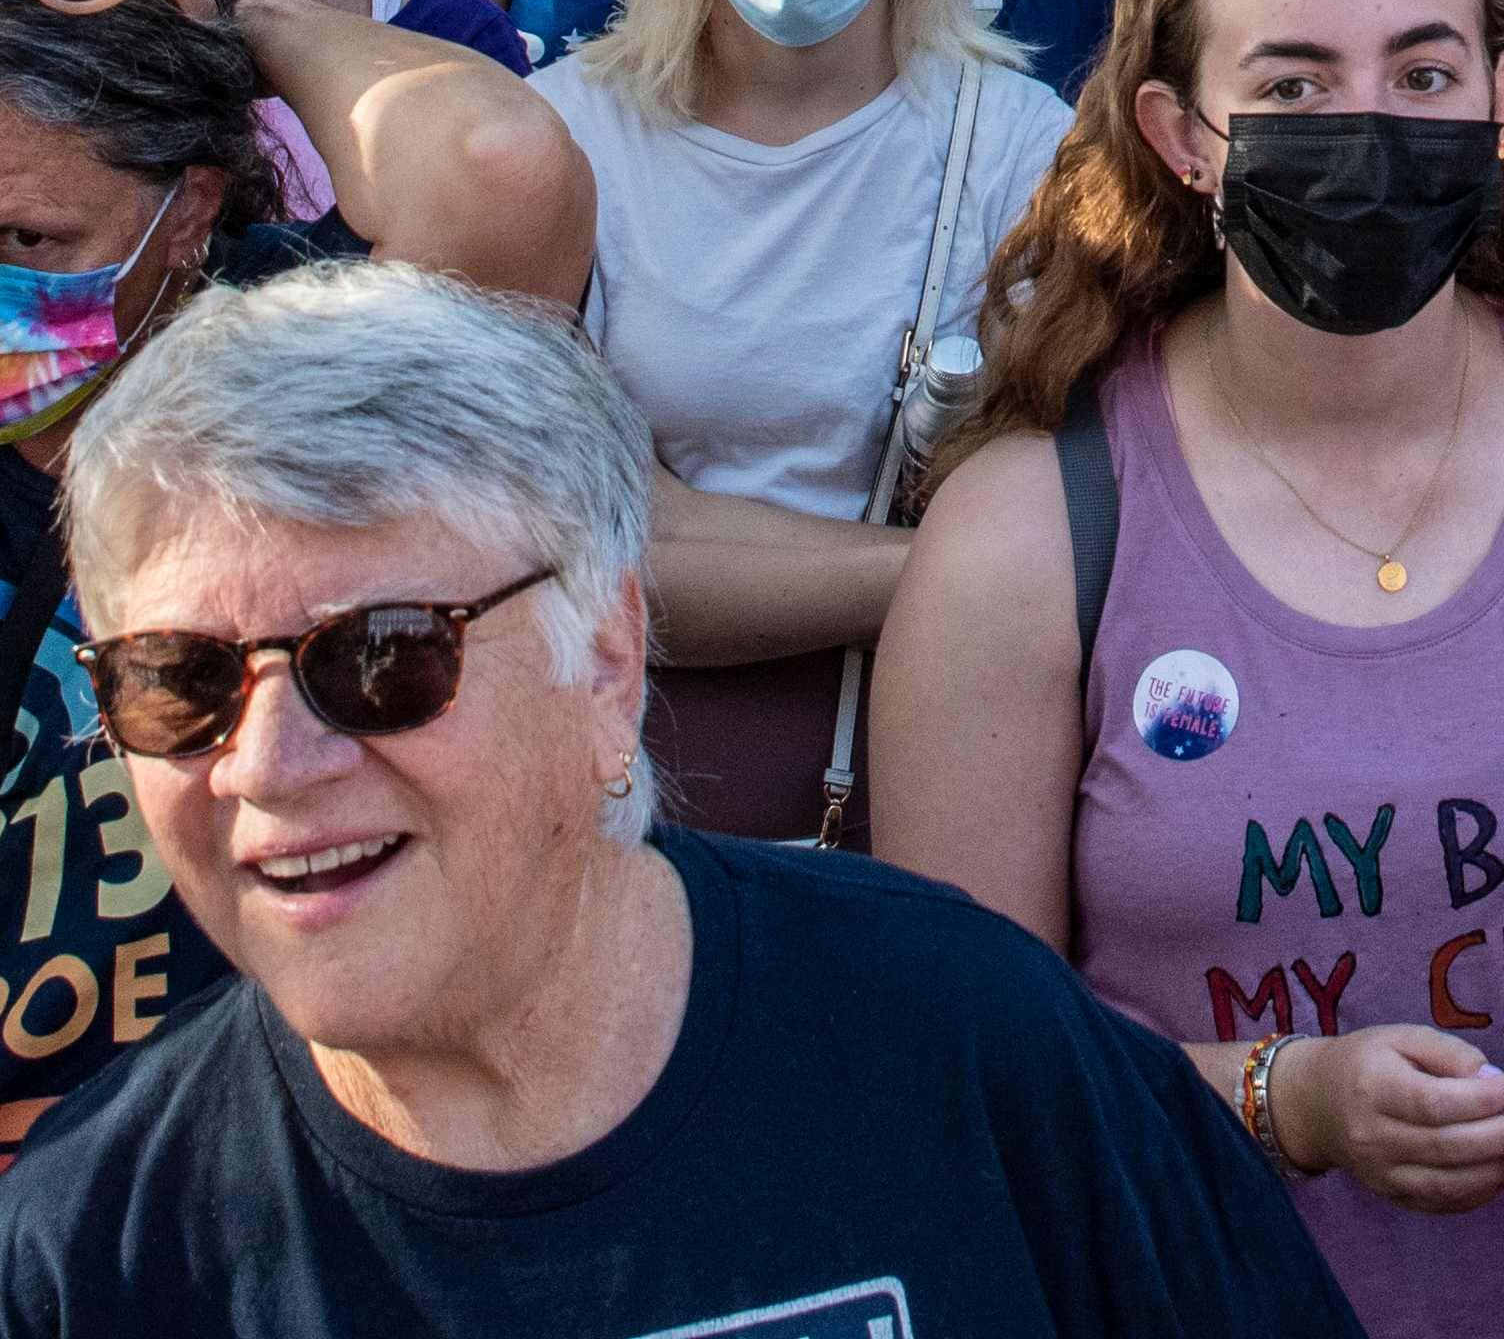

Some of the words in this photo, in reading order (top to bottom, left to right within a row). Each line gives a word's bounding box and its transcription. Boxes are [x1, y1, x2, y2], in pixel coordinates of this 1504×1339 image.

[1144, 701, 1159, 720] IS
[1149, 676, 1173, 702] THE
[1237, 803, 1395, 923] MY
[1204, 950, 1358, 1043] MY
